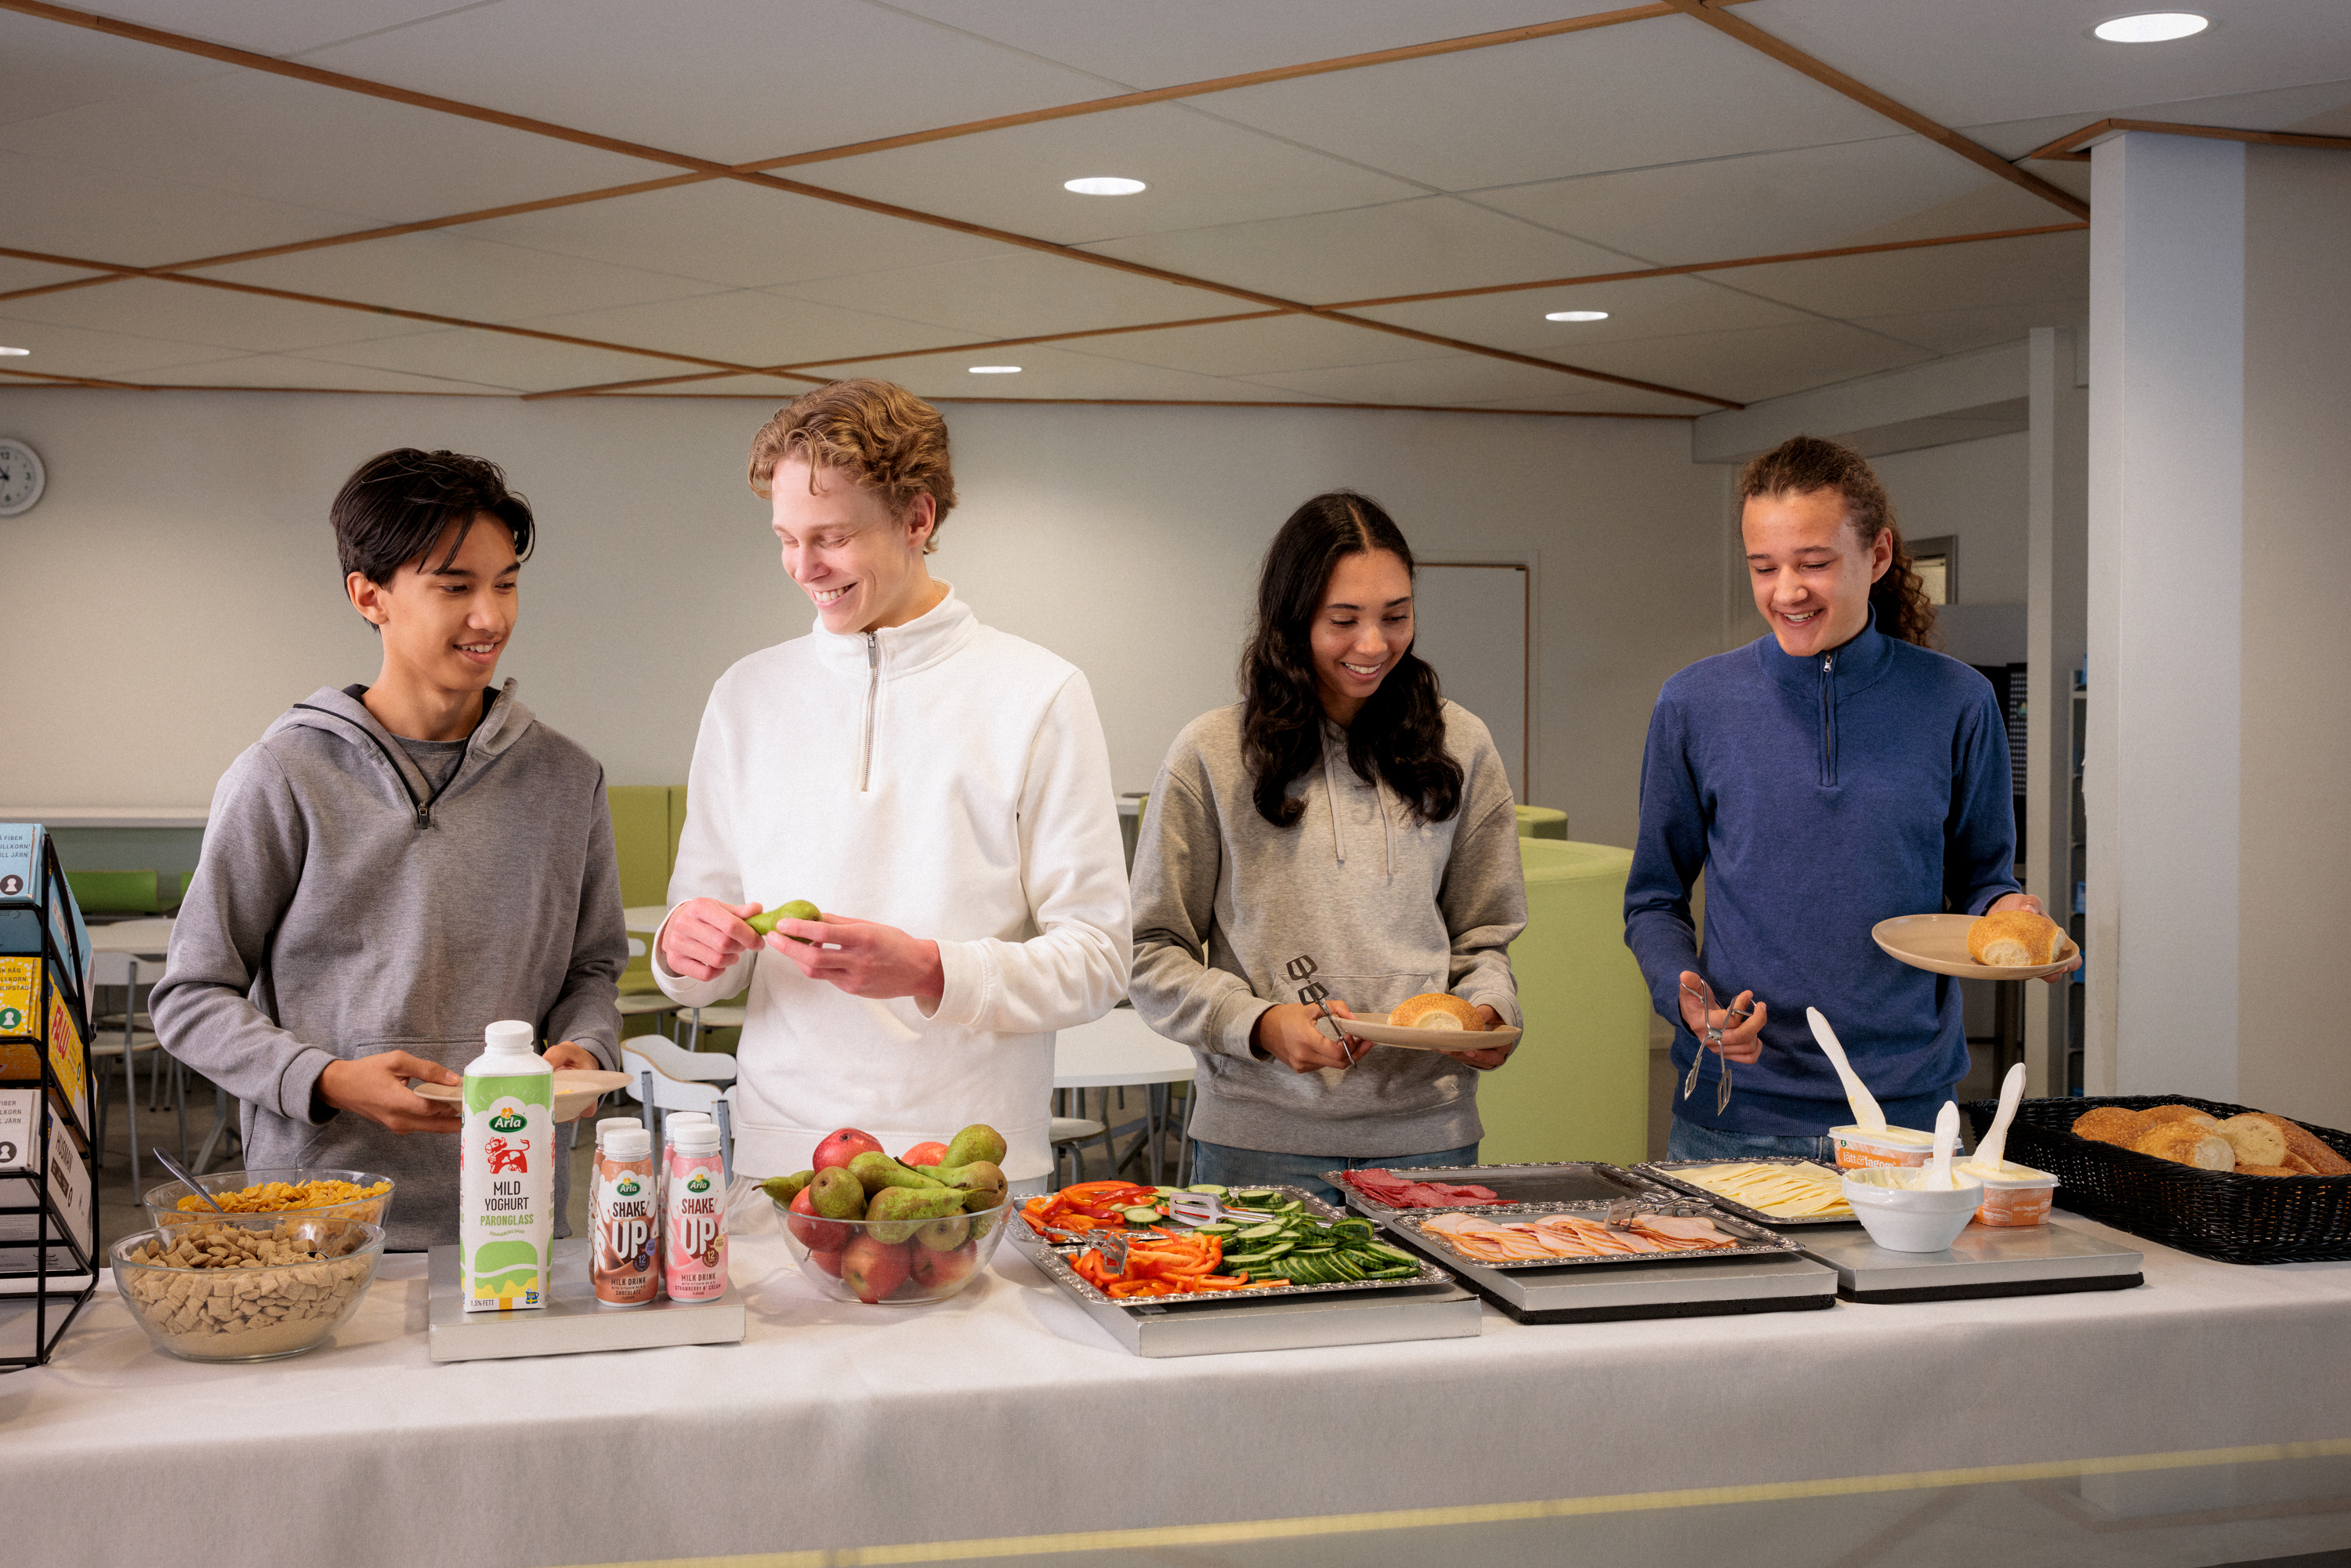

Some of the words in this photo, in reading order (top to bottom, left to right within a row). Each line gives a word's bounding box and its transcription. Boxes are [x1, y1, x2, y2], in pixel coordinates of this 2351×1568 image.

[51, 1004, 71, 1061] FALU
[494, 1117, 521, 1128] Arla
[494, 1181, 520, 1196] MILD
[620, 1184, 637, 1193] Arla
[690, 1180, 707, 1190] Arla
[485, 1197, 529, 1211] YOGHURT
[612, 1200, 646, 1218] SHAKE
[681, 1197, 715, 1215] SHAKE
[480, 1214, 534, 1226] PÄRONGLASS
[611, 1219, 647, 1259] UP
[680, 1217, 715, 1255] UP
[638, 1255, 647, 1264] 12
[707, 1250, 715, 1260] 12
[611, 1277, 626, 1286] MILK
[628, 1276, 647, 1286] DRINK
[697, 1273, 716, 1281] DRINK
